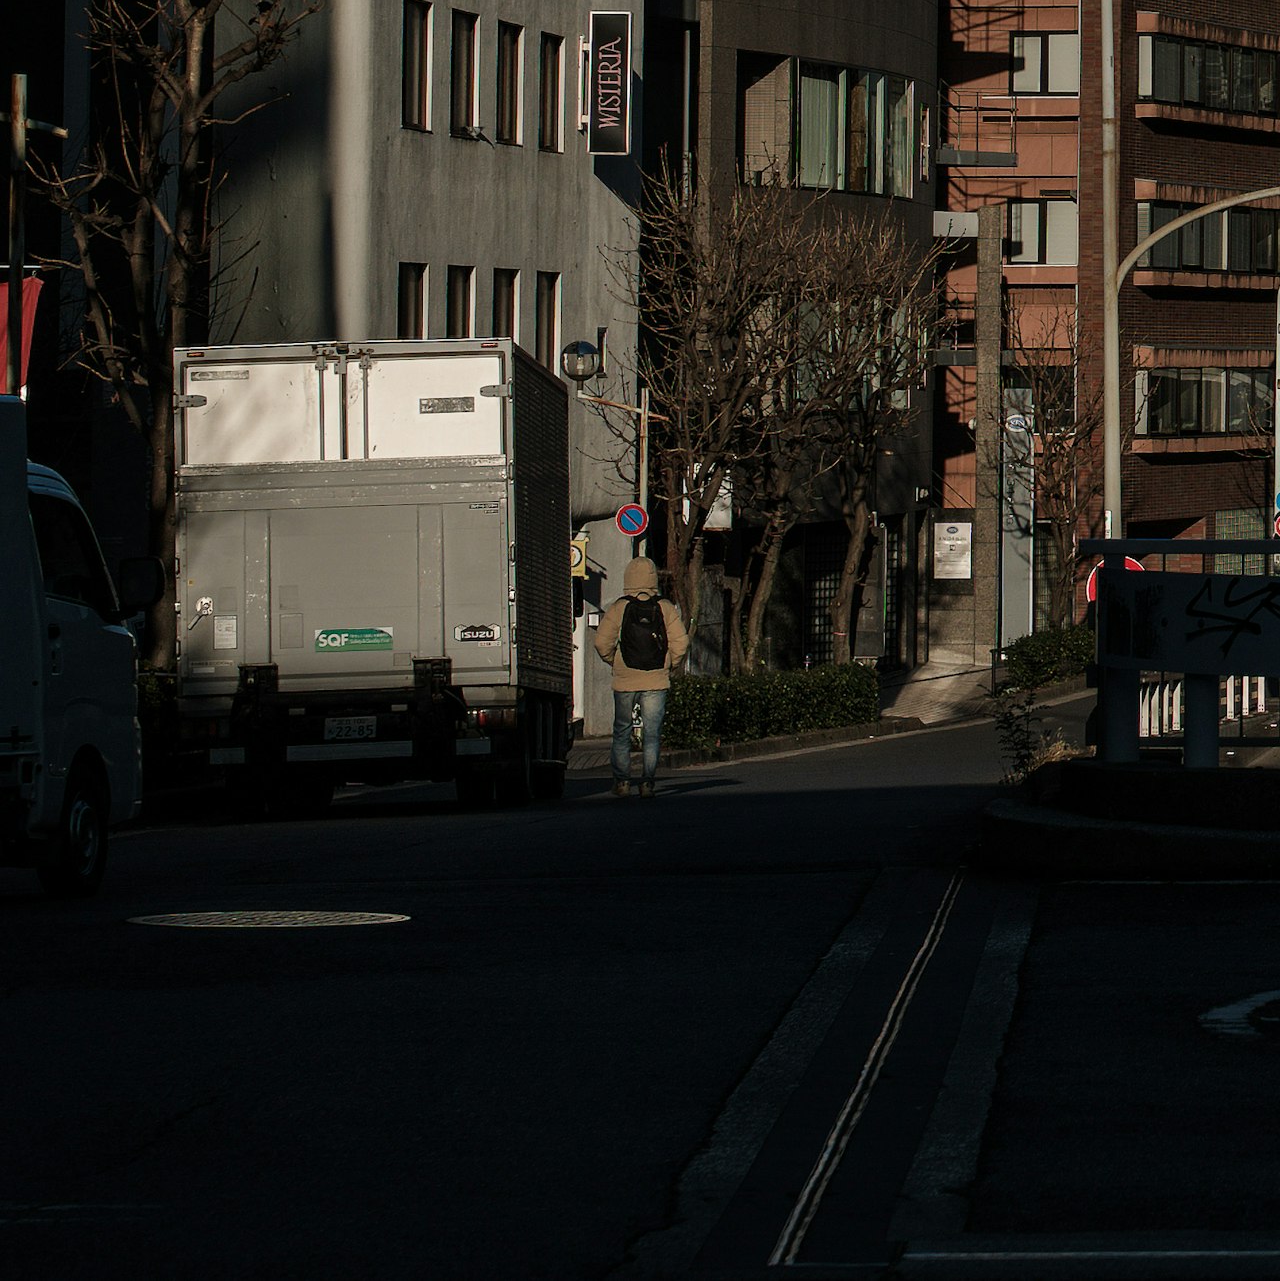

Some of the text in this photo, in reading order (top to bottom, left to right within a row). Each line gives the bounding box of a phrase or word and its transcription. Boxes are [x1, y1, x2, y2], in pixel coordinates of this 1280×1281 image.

[598, 36, 622, 129] WISTERIA
[318, 633, 349, 648] SQF
[461, 630, 494, 639] ISUZU
[335, 724, 374, 737] 22-85
